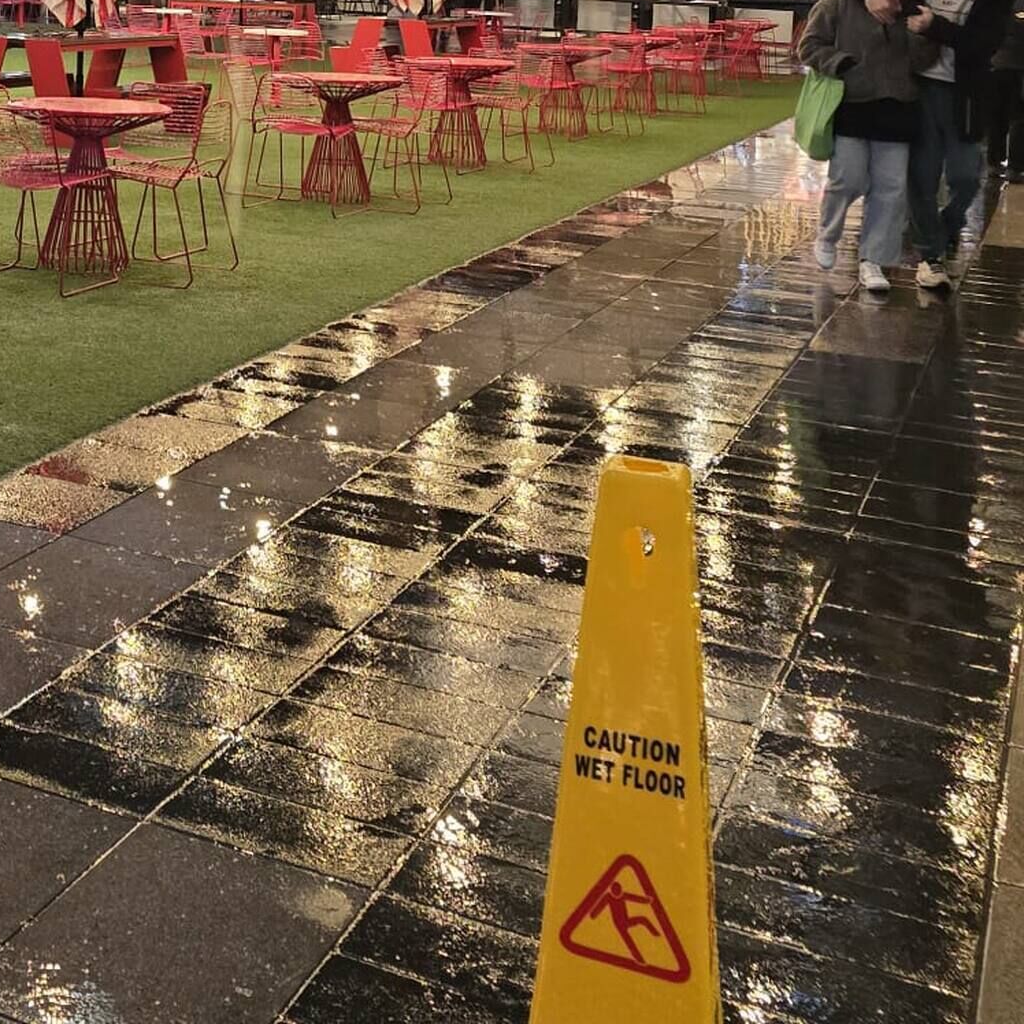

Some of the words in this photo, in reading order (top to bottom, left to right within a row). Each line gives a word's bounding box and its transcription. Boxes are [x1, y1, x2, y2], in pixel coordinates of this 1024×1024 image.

[583, 726, 680, 766] CAUTION
[575, 754, 615, 783] WET
[622, 764, 685, 799] FLOOR
